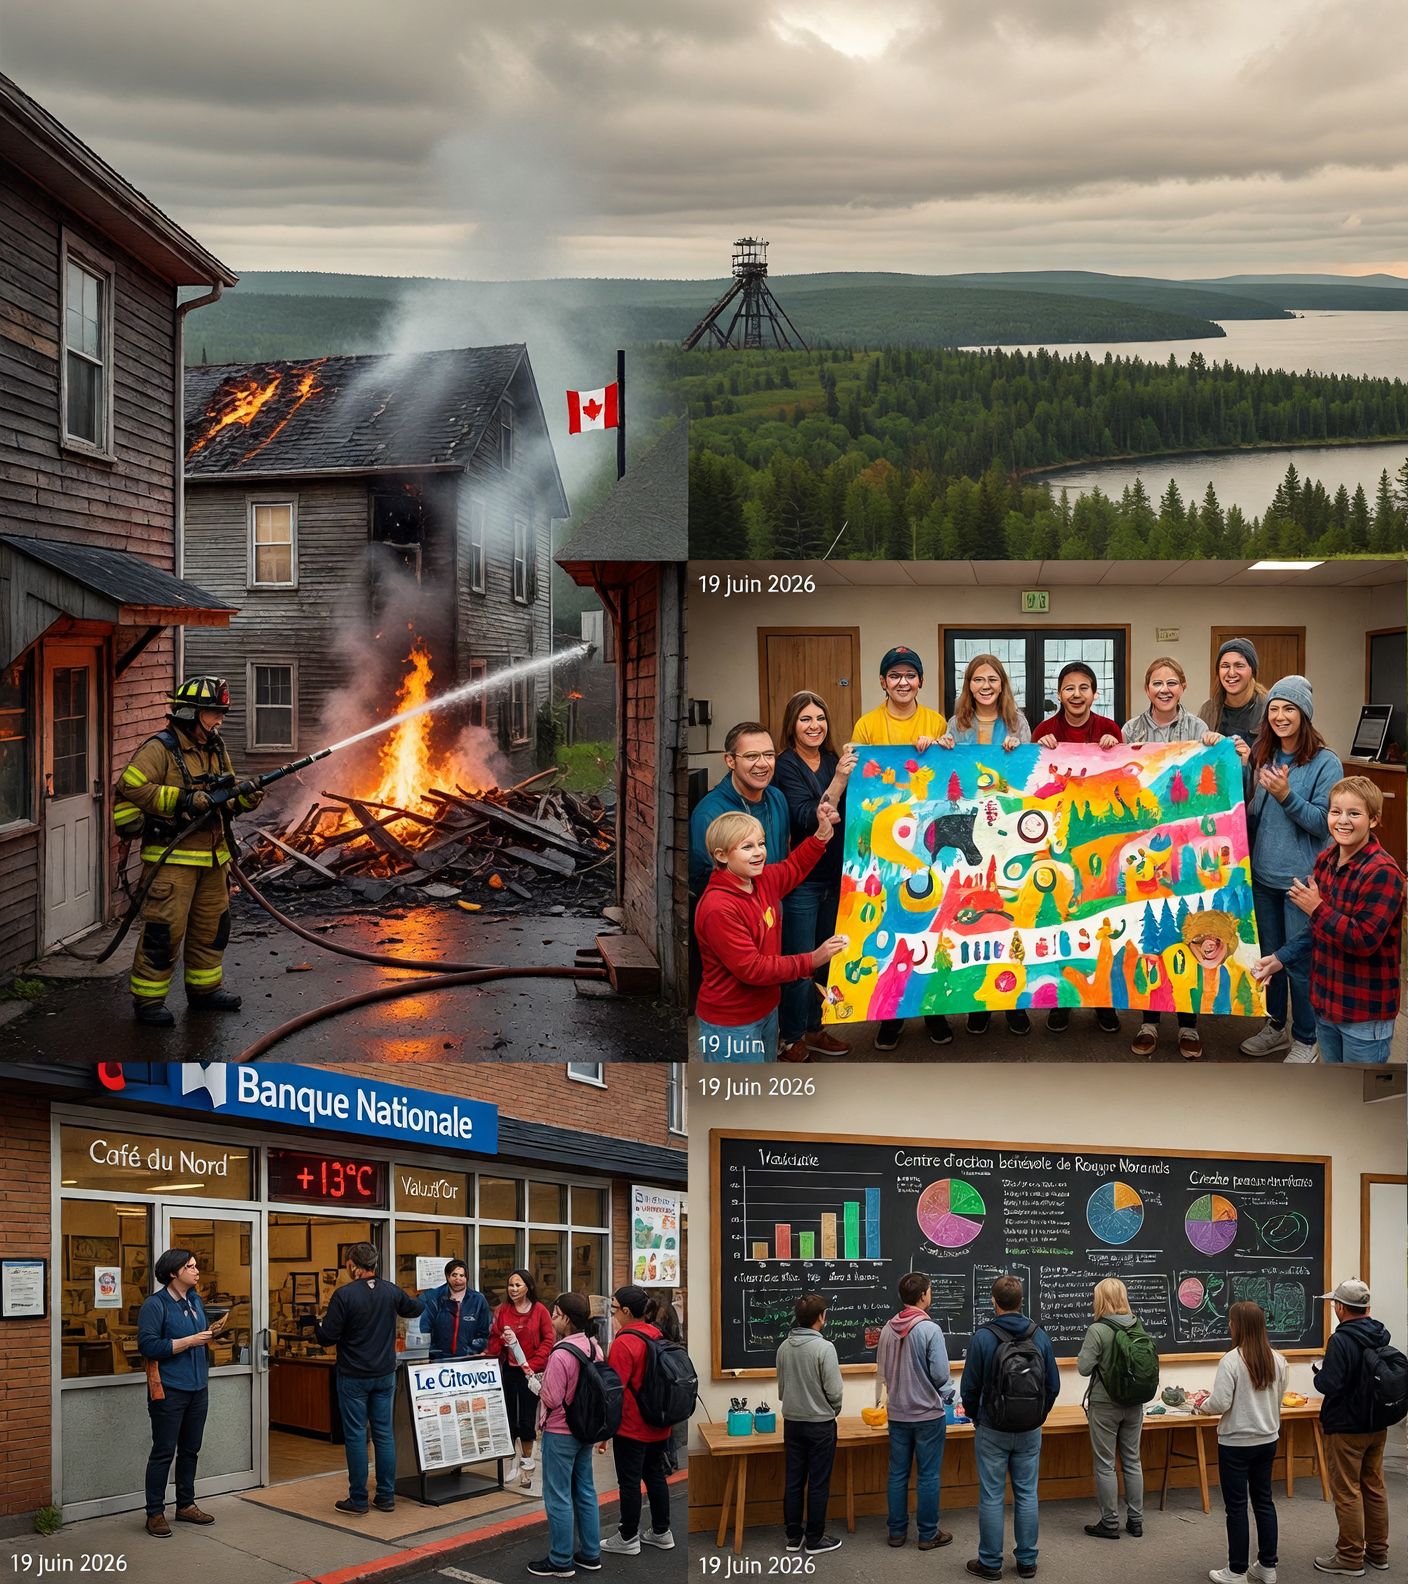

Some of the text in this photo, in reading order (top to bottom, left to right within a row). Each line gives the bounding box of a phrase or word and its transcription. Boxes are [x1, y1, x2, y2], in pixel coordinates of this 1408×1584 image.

[238, 1065, 473, 1140] Banque Nationale
[89, 1140, 228, 1177] Café du Nord
[894, 1150, 941, 1168] Centre
[1056, 1156, 1071, 1171] de
[415, 1368, 496, 1391] Le Citoyen
